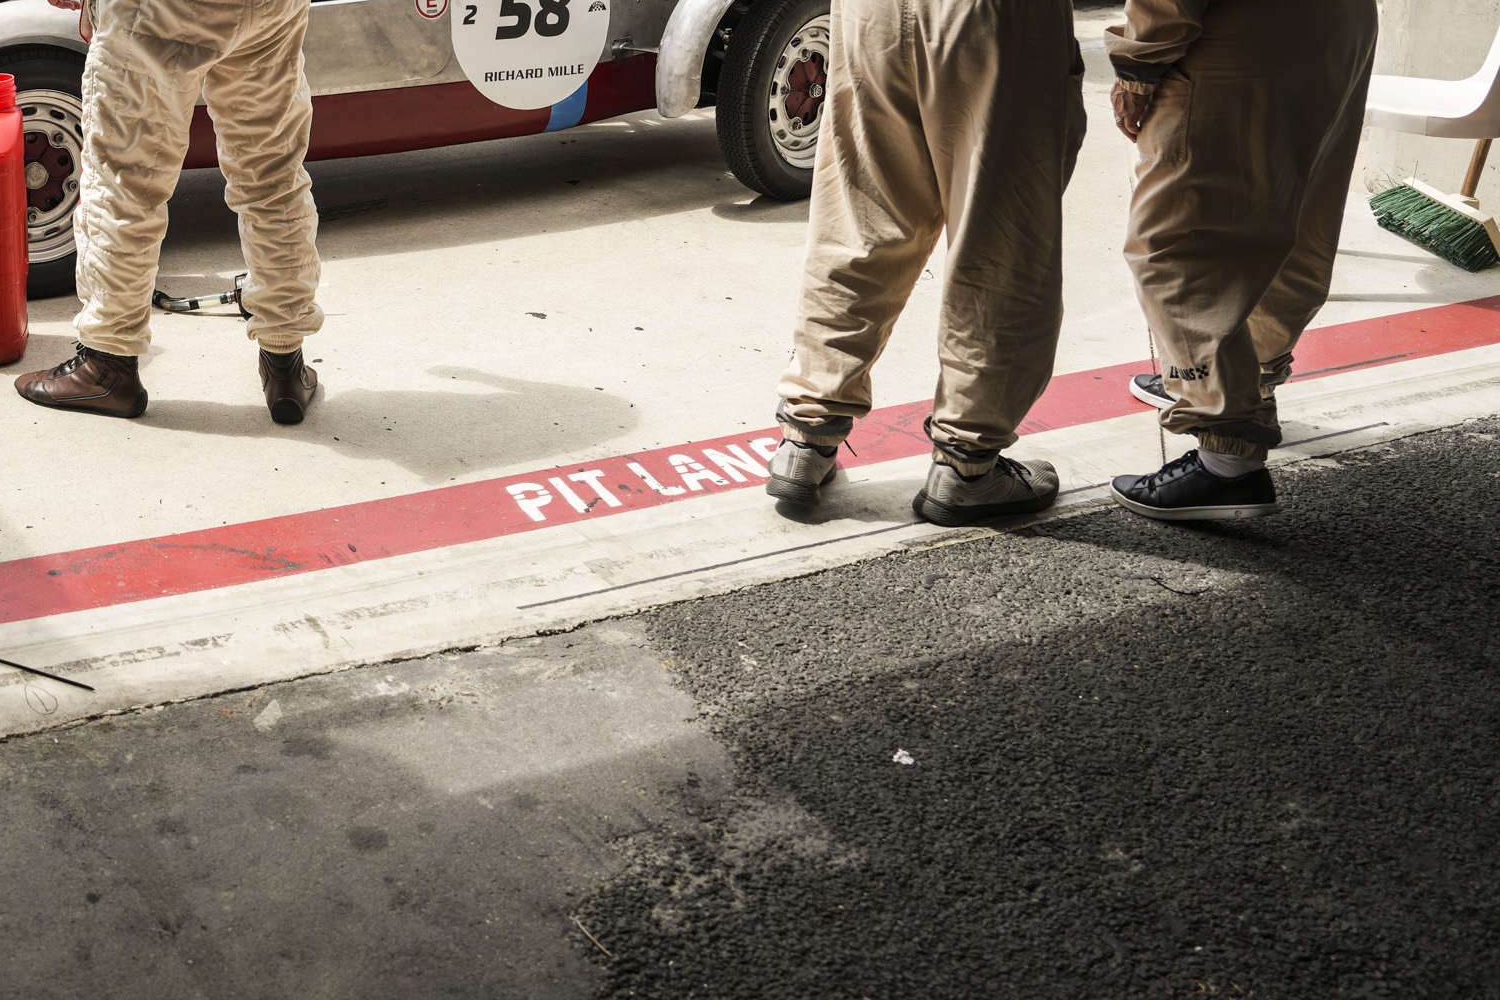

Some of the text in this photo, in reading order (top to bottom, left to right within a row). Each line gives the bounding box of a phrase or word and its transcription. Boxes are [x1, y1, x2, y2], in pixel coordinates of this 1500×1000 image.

[463, 5, 477, 25] 2
[484, 64, 584, 82] RICHARD MILLE
[504, 469, 622, 522] PIT
